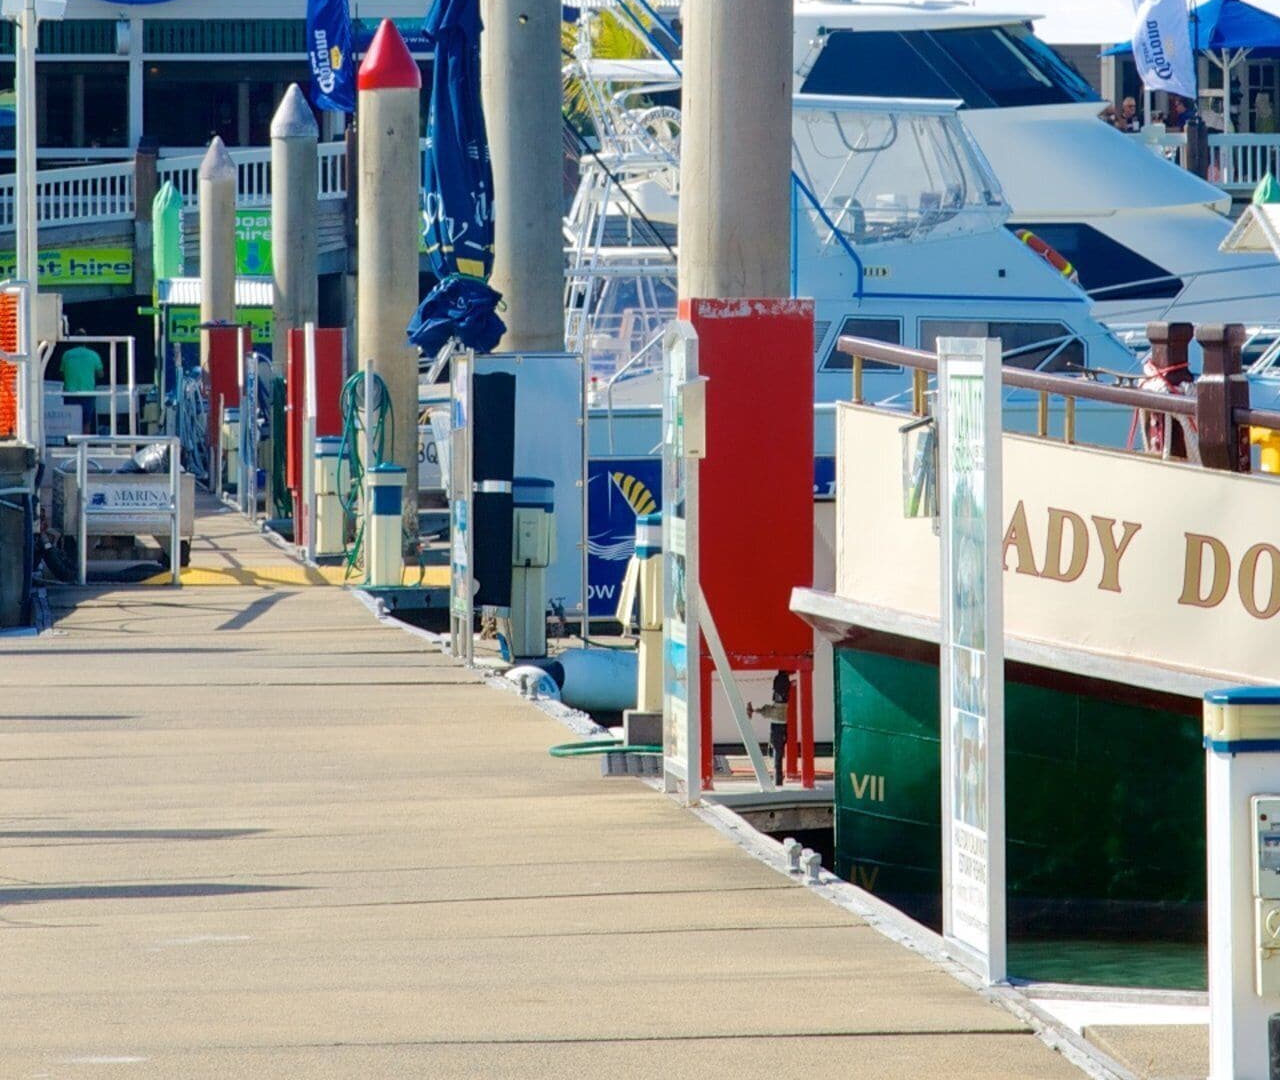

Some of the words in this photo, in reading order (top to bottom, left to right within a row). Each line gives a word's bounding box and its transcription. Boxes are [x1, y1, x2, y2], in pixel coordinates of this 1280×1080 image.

[314, 29, 335, 94] Corona
[1146, 20, 1173, 80] Corona
[70, 258, 131, 276] hire
[114, 490, 168, 502] MARINA
[1002, 499, 1142, 593] ADY
[850, 772, 885, 802] VII
